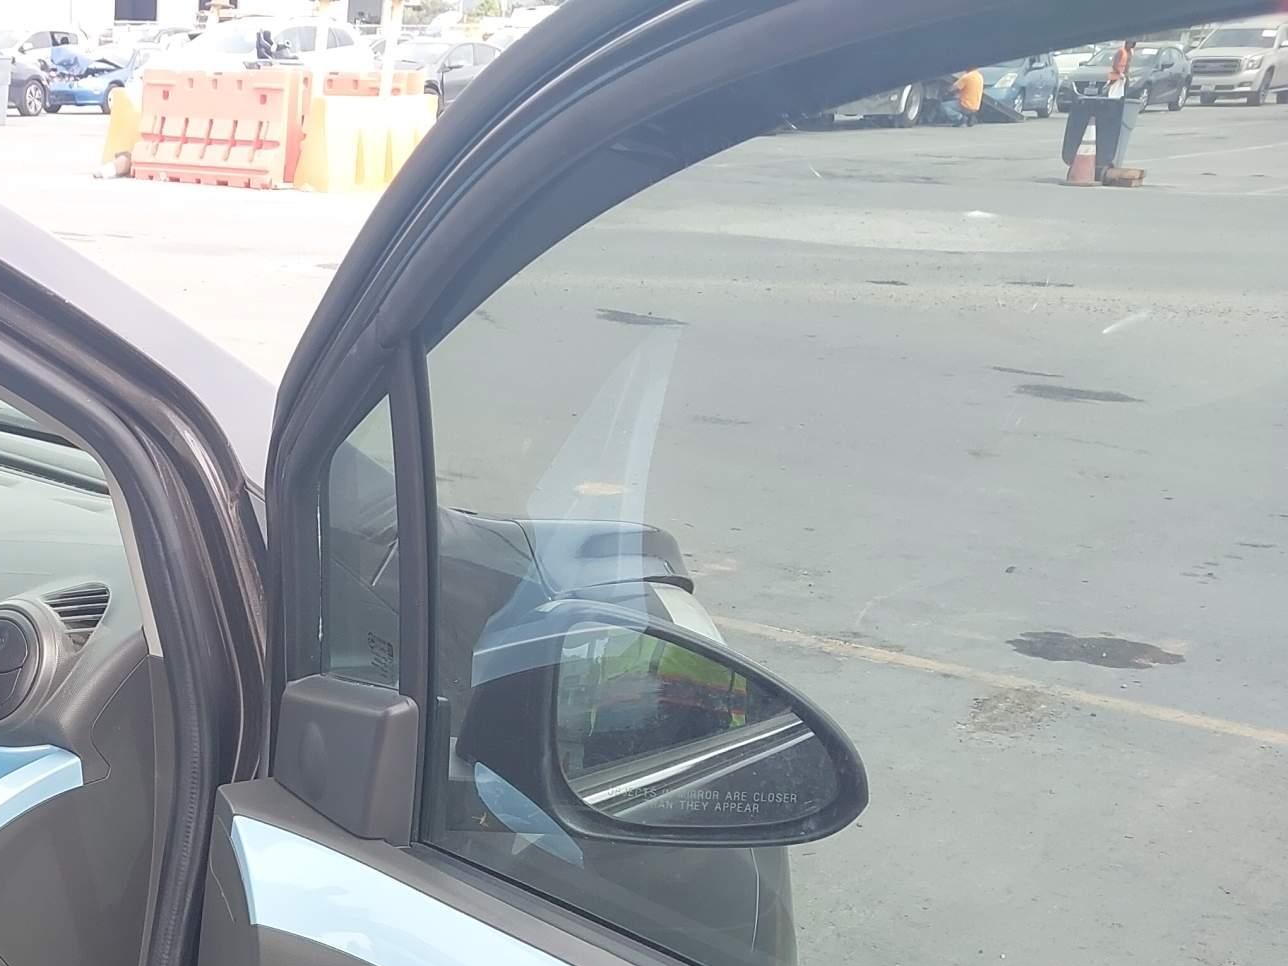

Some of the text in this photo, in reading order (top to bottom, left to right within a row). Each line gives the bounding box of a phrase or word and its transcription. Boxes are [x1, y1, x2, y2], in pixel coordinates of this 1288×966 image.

[725, 791, 748, 802] ARE
[753, 792, 798, 804] CLOSER
[679, 800, 709, 811] THEY
[714, 801, 760, 813] APPEAR
